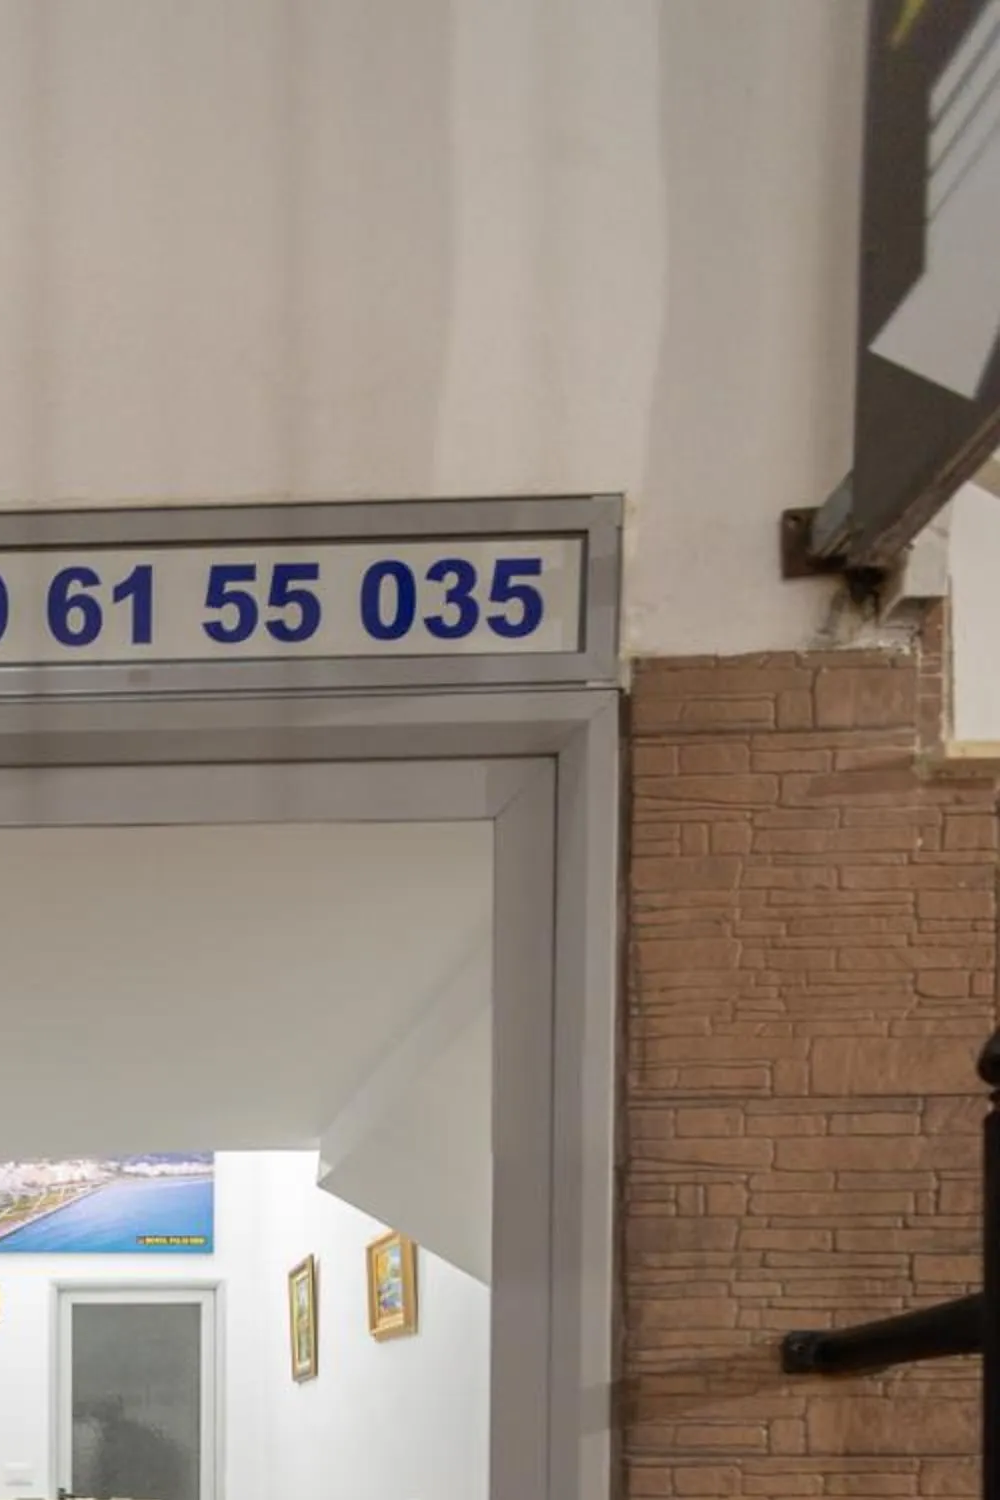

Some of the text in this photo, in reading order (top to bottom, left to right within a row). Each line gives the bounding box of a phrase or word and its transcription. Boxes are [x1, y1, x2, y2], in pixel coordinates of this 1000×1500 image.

[47, 565, 152, 647] 61
[202, 562, 322, 644] 55
[360, 557, 544, 640] 035
